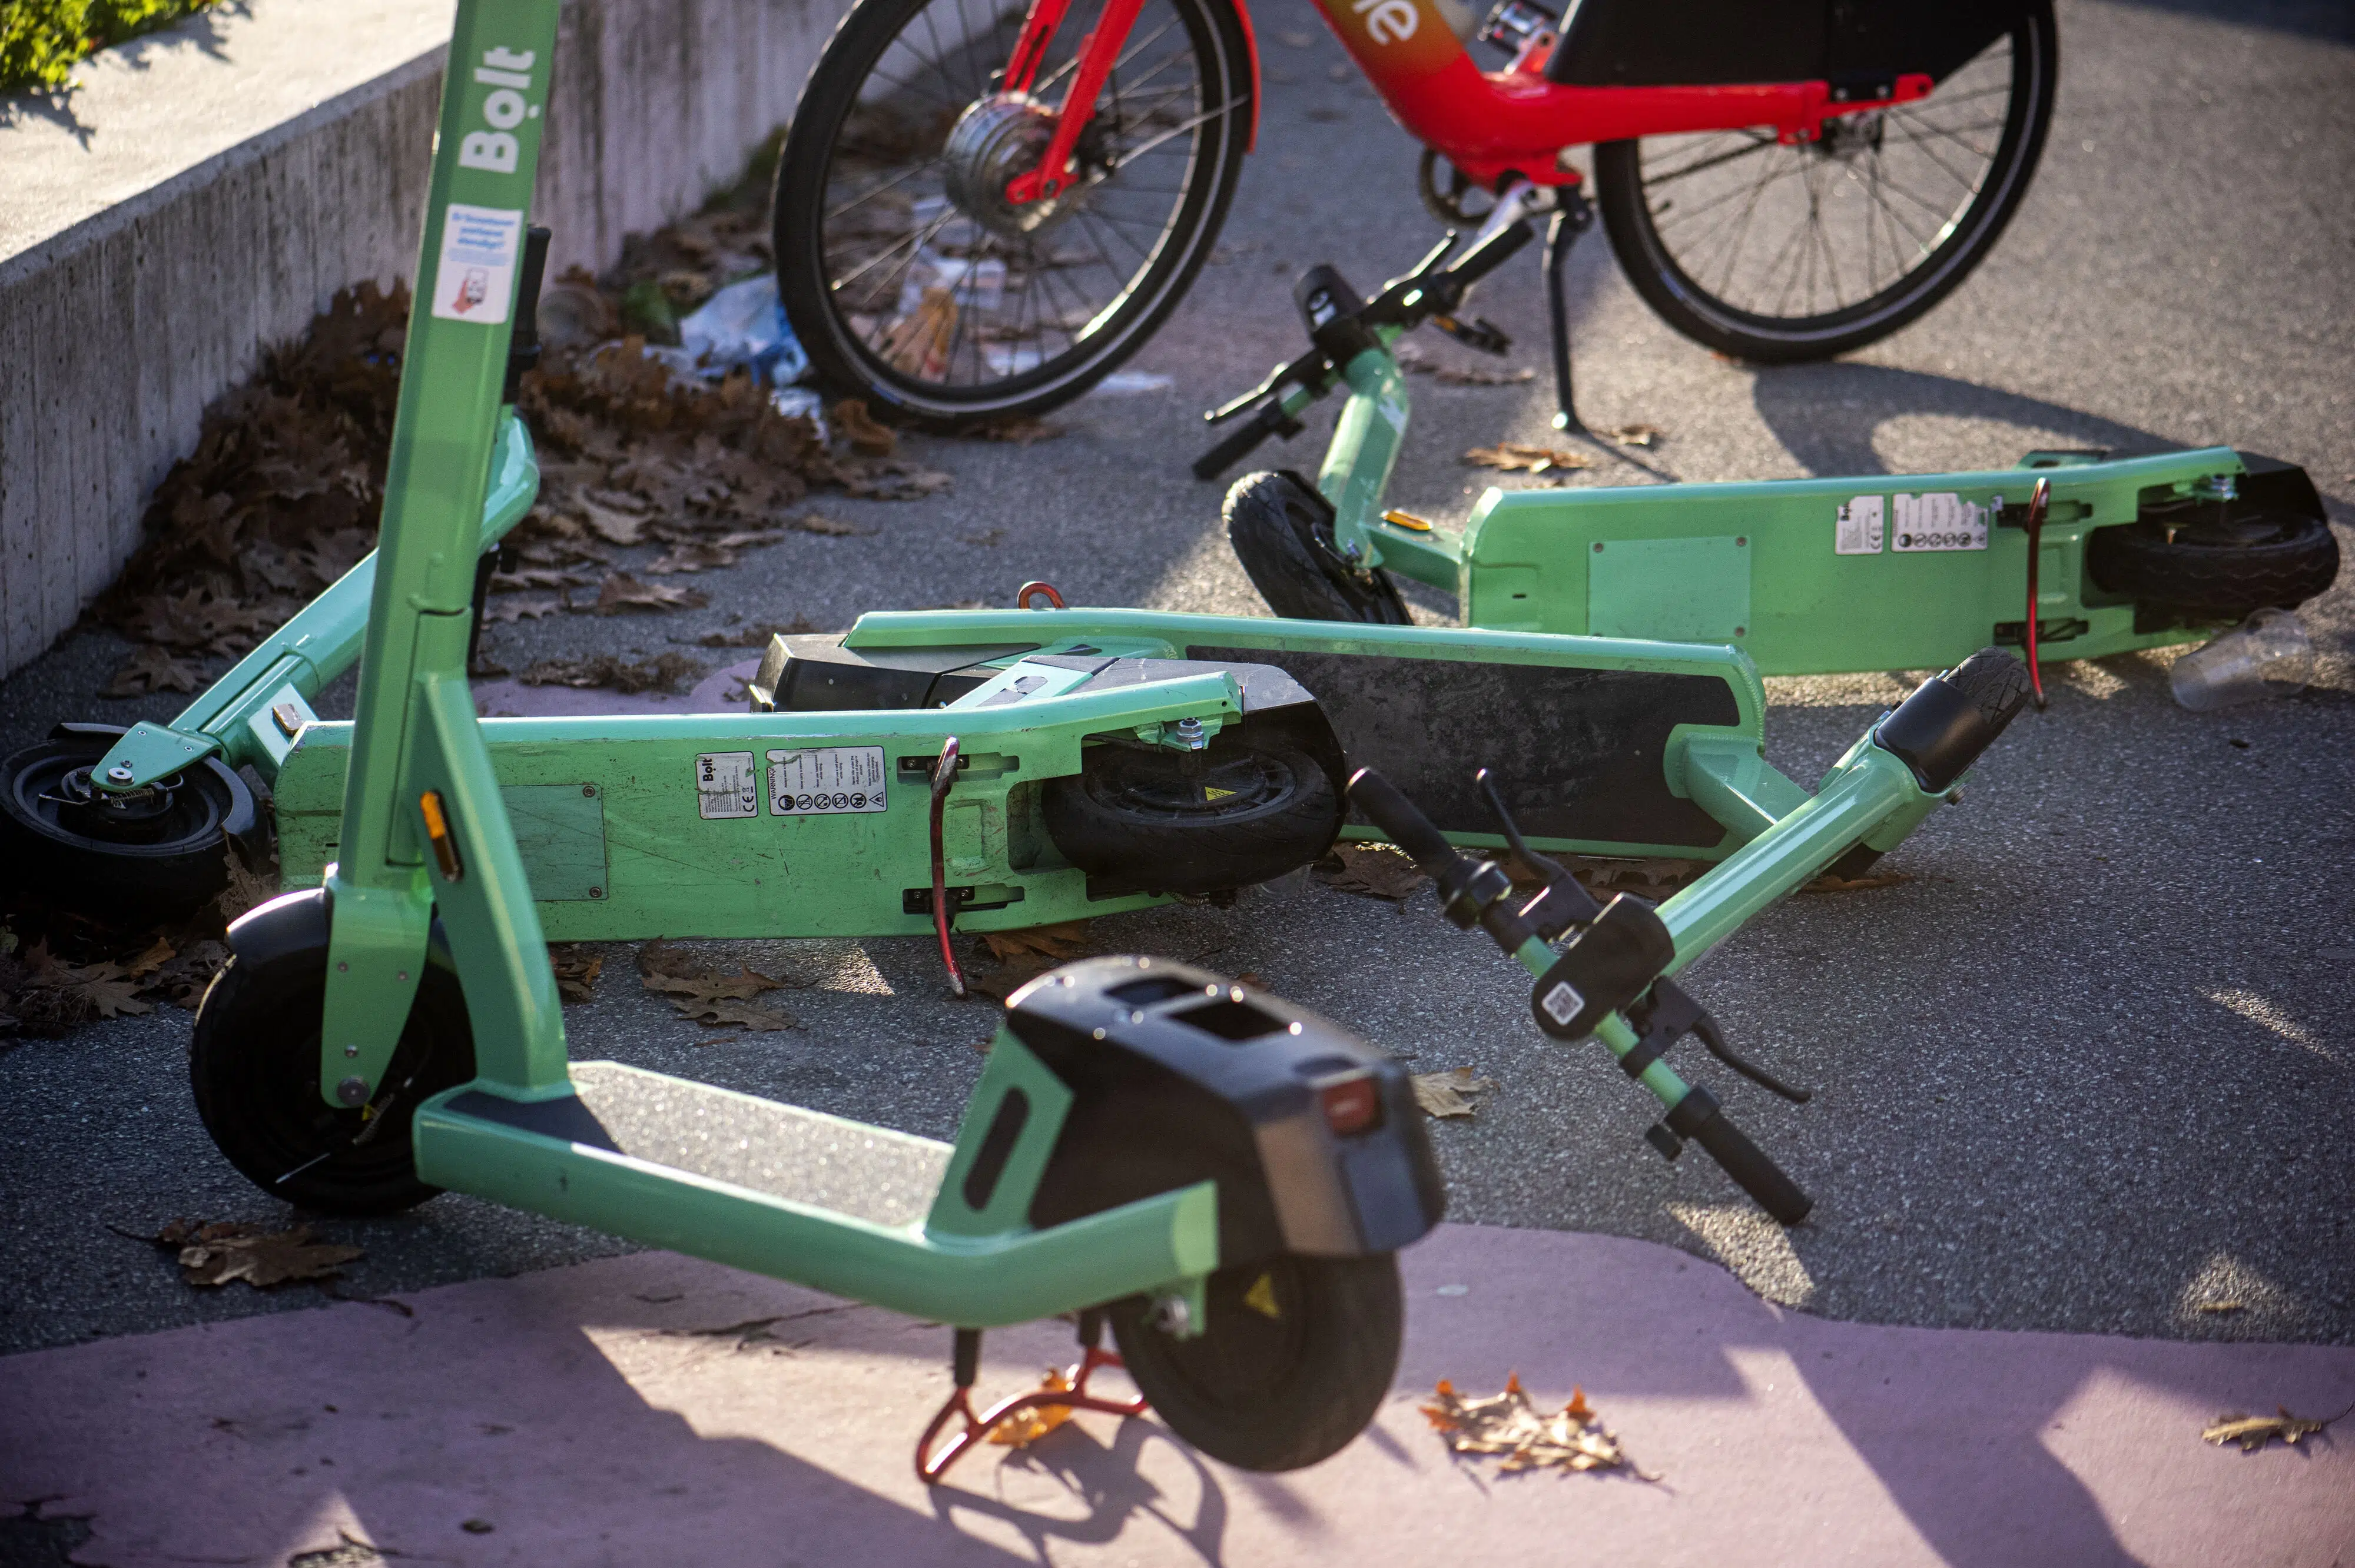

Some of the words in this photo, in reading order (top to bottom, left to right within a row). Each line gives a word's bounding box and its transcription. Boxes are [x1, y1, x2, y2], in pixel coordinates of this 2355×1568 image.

[458, 46, 540, 174] Bolt
[702, 758, 716, 782] Bolt
[742, 796, 755, 812] CE
